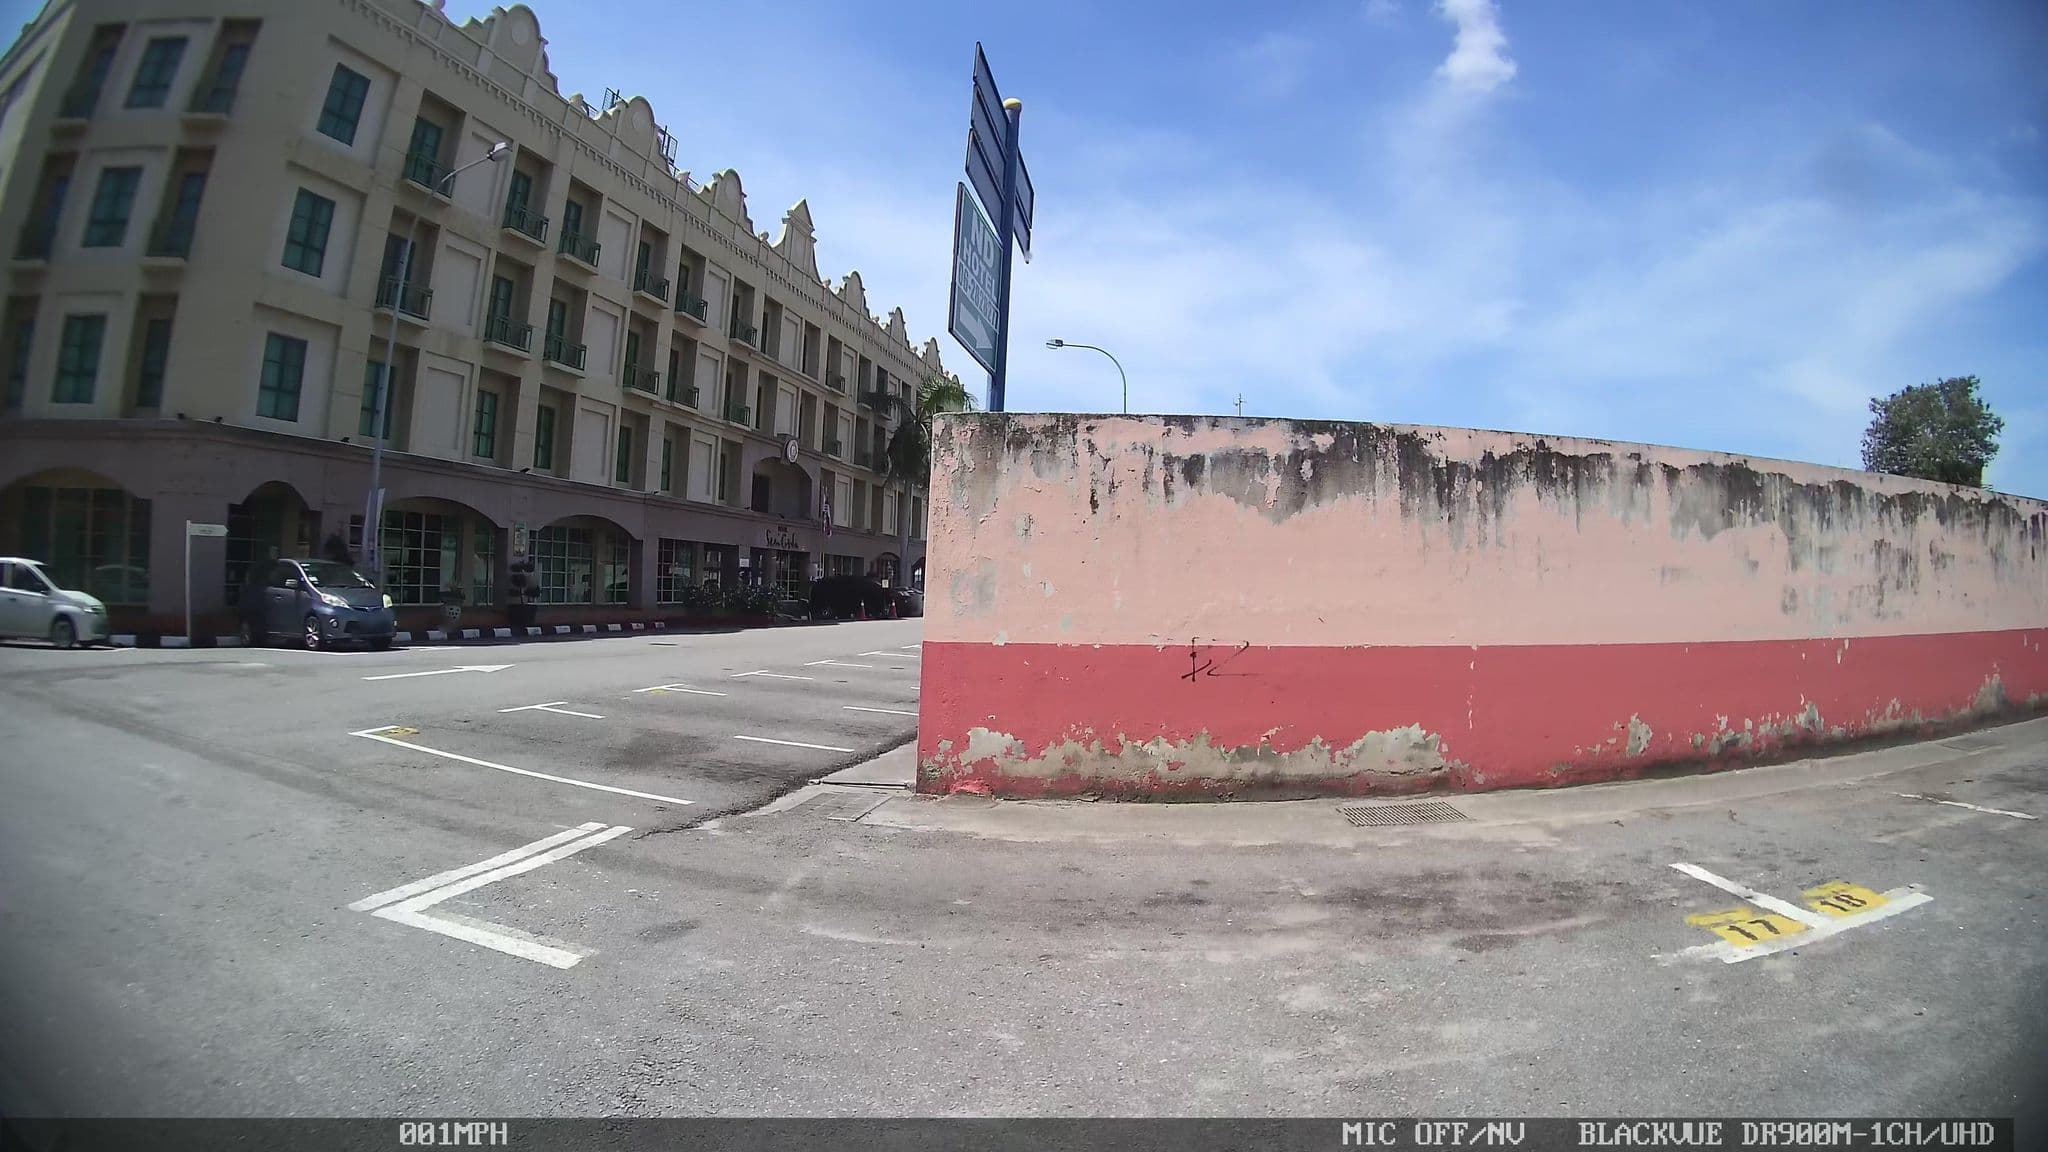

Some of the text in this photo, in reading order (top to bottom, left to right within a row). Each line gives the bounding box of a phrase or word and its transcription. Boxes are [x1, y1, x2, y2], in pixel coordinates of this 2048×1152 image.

[971, 208, 994, 268] ND
[963, 236, 998, 305] HOTEL
[1820, 893, 1868, 912] 18
[1727, 919, 1781, 941] 17
